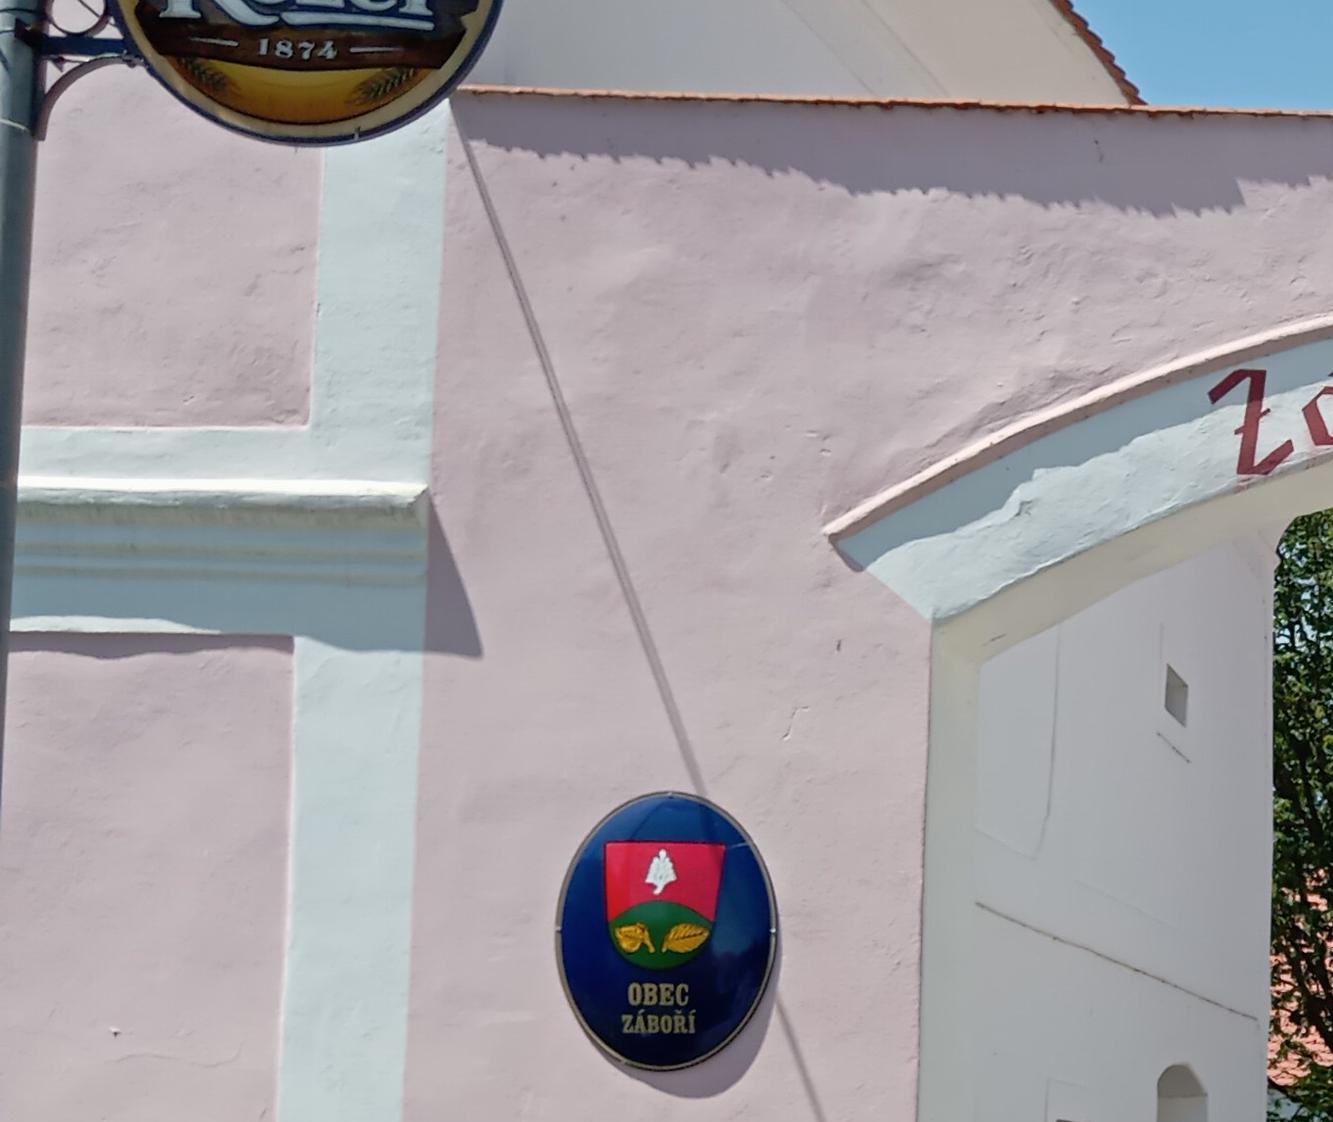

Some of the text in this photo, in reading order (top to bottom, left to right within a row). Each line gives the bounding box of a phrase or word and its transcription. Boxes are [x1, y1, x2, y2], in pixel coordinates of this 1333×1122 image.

[258, 38, 338, 61] 1874
[627, 982, 690, 1007] OBEC
[621, 1008, 697, 1035] ZÁBOŘÍ
